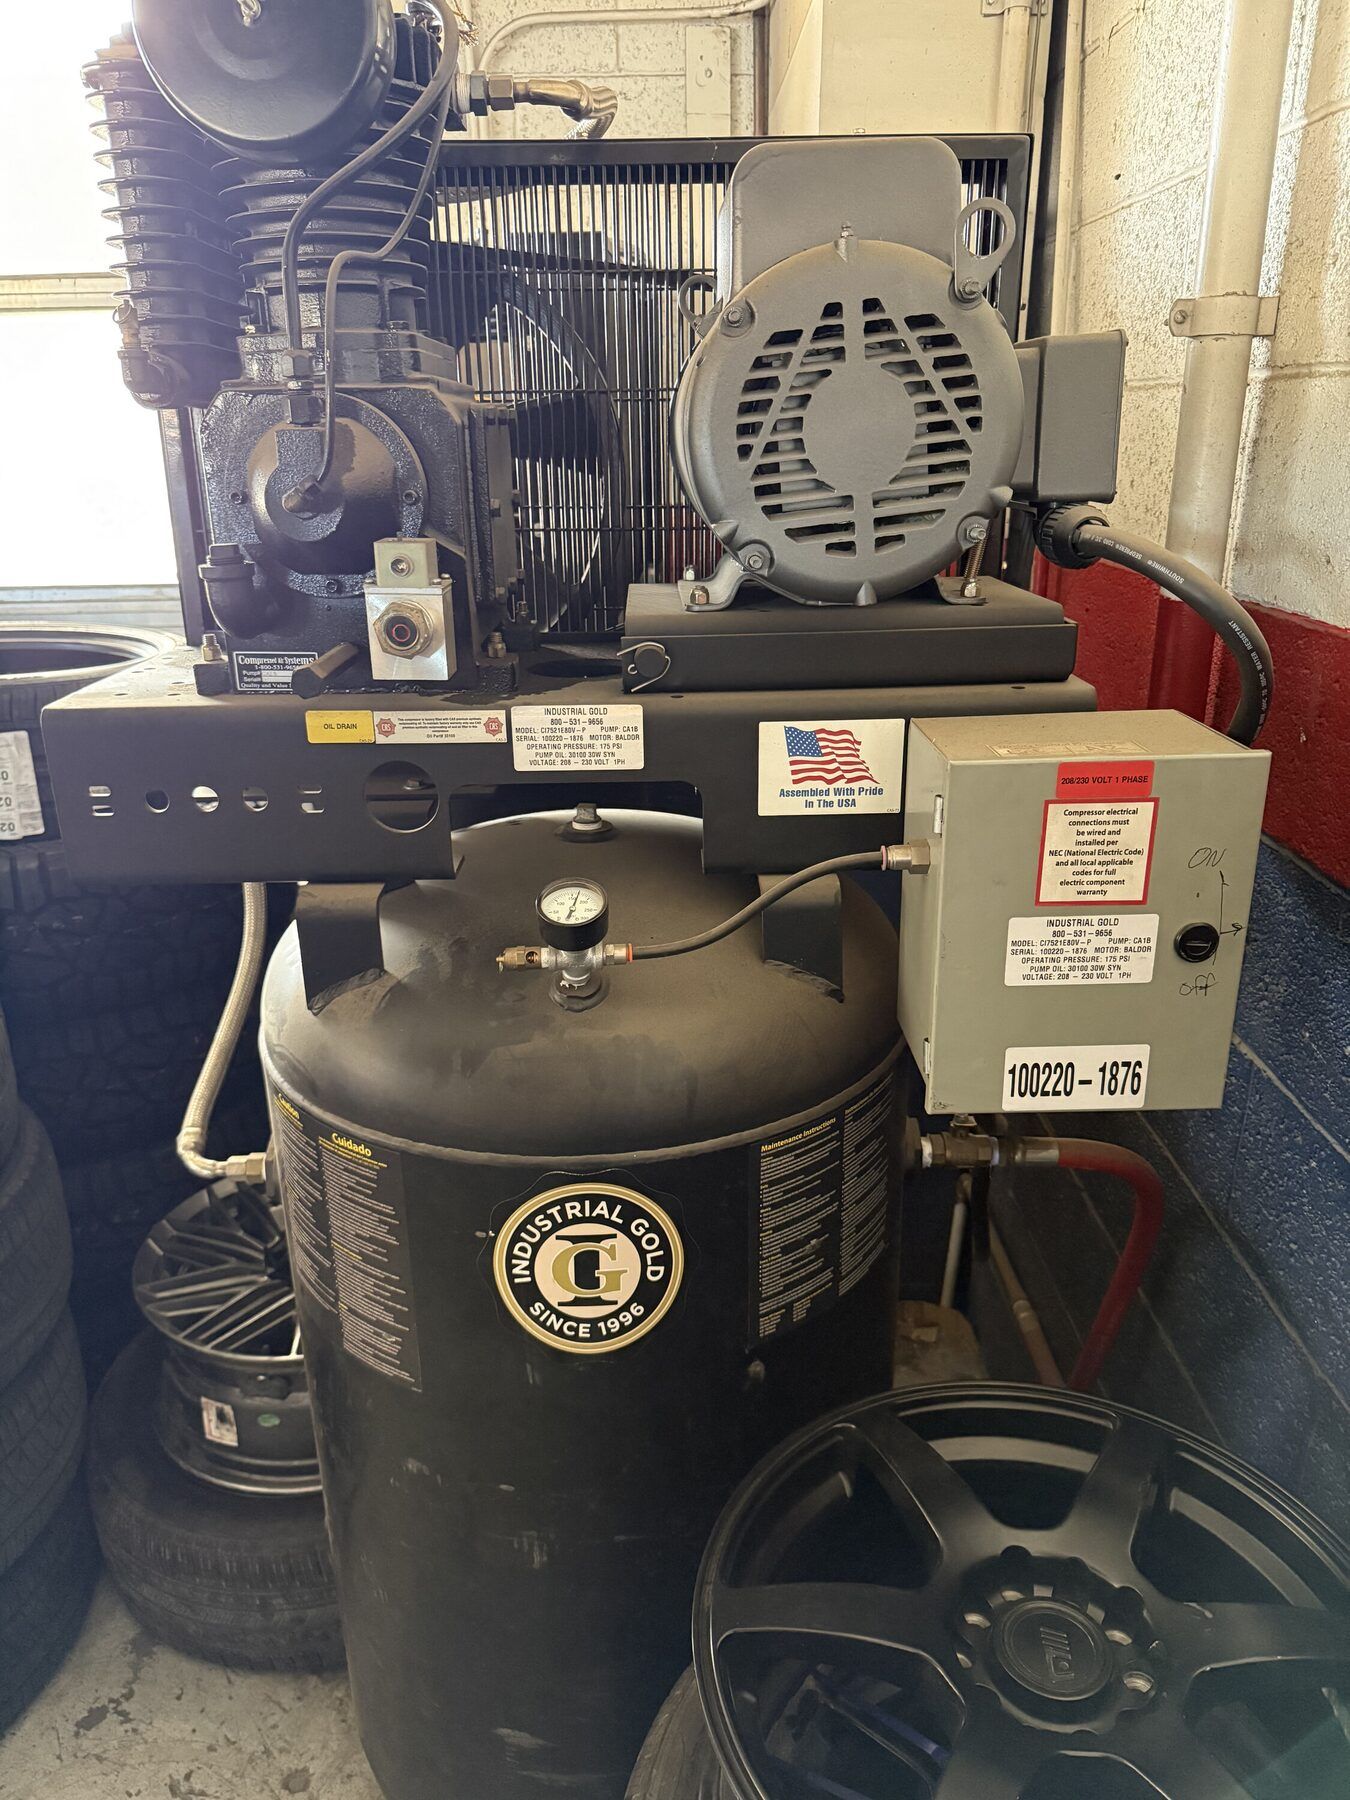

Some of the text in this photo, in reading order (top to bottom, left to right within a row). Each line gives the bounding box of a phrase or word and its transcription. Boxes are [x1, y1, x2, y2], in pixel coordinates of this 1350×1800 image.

[1228, 620, 1253, 650] RESISTANT
[239, 655, 277, 665] Compressed
[284, 657, 314, 665] Systems
[1251, 652, 1263, 671] WATER
[544, 707, 608, 716] INDUSTRIAL GOLD
[555, 751, 567, 759] OIL:
[569, 751, 587, 759] 30100
[529, 759, 558, 767] VOLTAGE:
[1061, 777, 1089, 785] 208/230
[1092, 776, 1113, 784] VOLT
[1122, 775, 1148, 783] PHASE
[779, 786, 884, 797] Assembled With Pride
[805, 798, 856, 808] In The USA
[1063, 809, 1105, 817] Compressor
[1064, 849, 1096, 857] (National
[1124, 848, 1144, 856] Code)
[1187, 847, 1227, 869] ON
[1098, 859, 1133, 867] applicable
[1086, 879, 1125, 887] component
[1046, 918, 1119, 927] INDUSTRIAL GOLD
[1052, 929, 1113, 937] 800-531-9656
[1011, 939, 1038, 947] MODEL:
[1108, 937, 1131, 945] PUMP:
[1133, 937, 1151, 945] CA1B
[1010, 947, 1038, 955] SERIAL:
[1094, 946, 1122, 954] MOTOR:
[1021, 956, 1061, 964] OPERATING
[1090, 964, 1106, 972] 30W
[1022, 973, 1056, 981] VOLTAGE:
[1081, 972, 1094, 980] 230
[1096, 972, 1113, 980] VOLT
[761, 1116, 836, 1153] Maintenance Instructions
[332, 1132, 372, 1157] Cuidado
[512, 1200, 666, 1284] INDUSTRIAL GOLD
[529, 1302, 645, 1338] SINCE 1996
